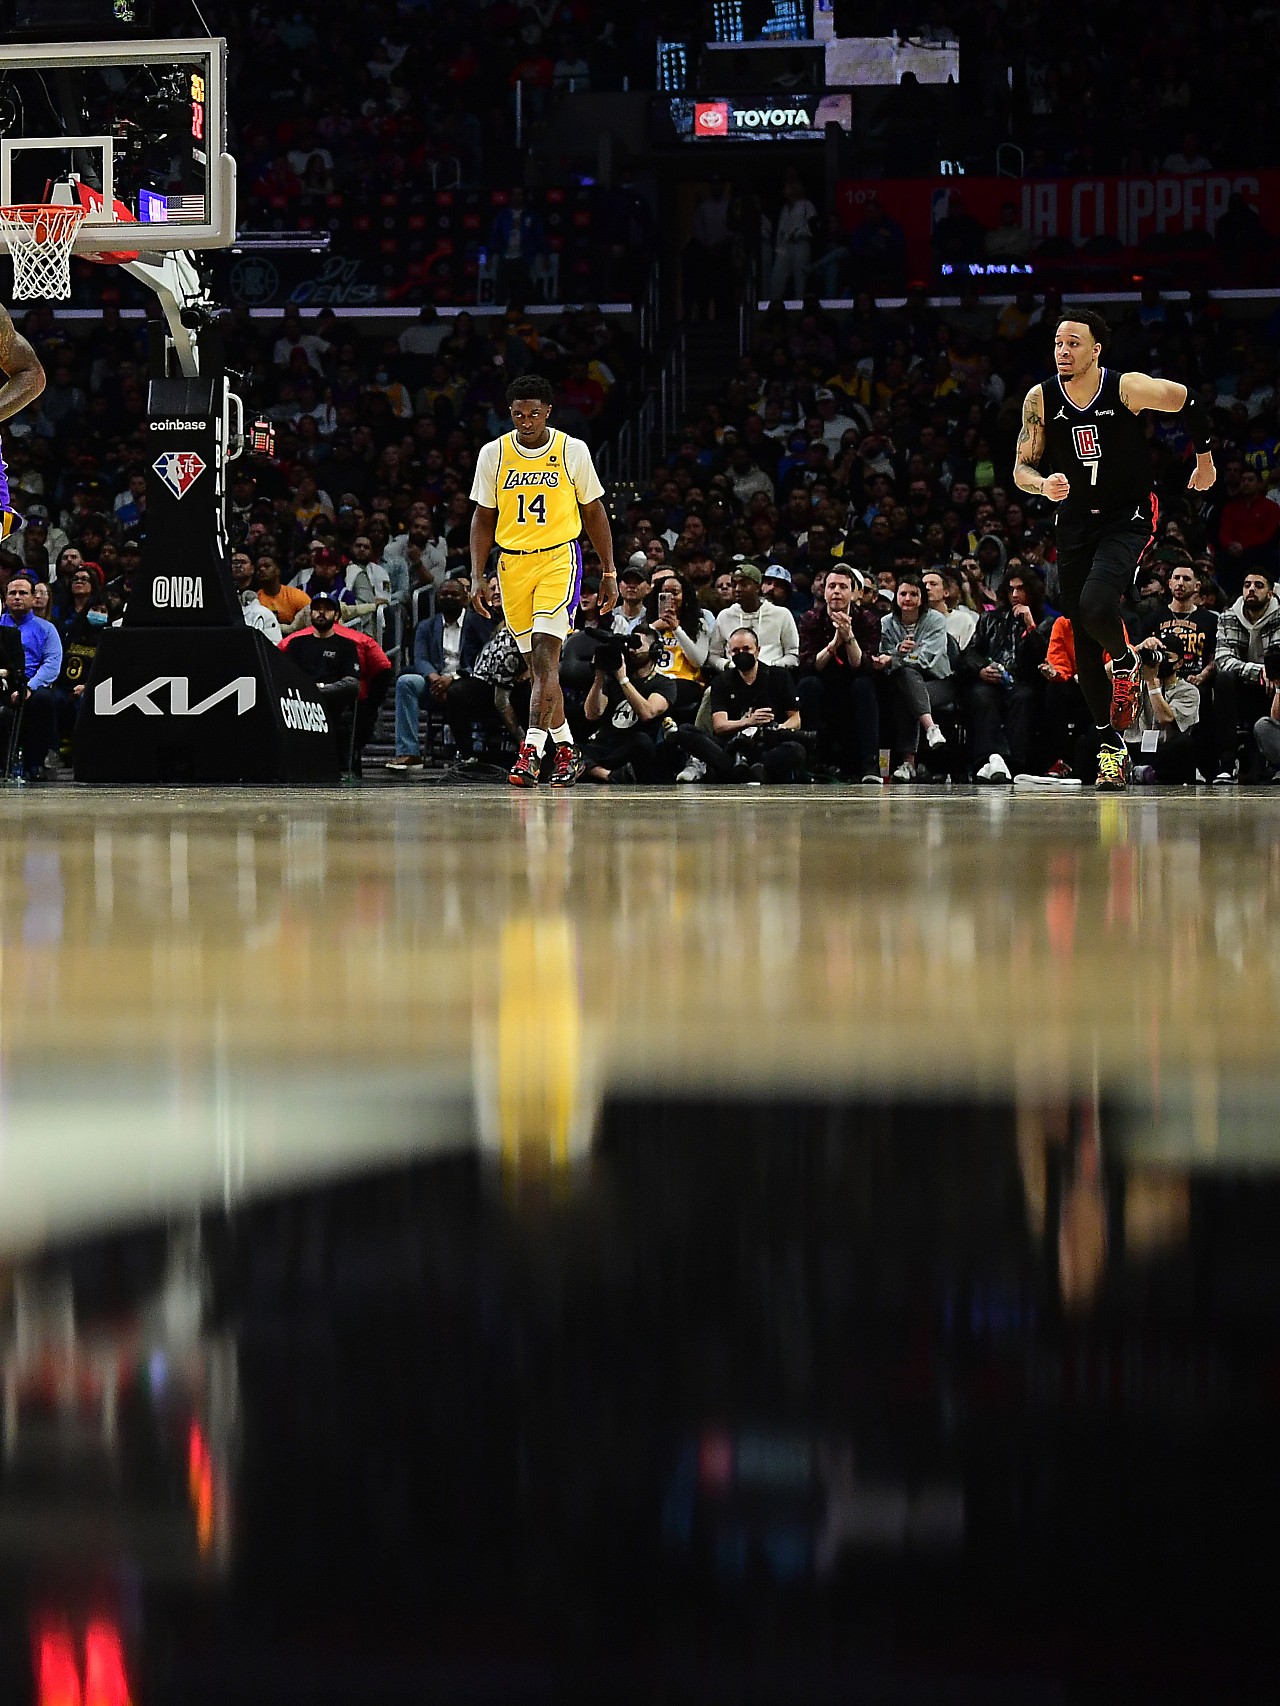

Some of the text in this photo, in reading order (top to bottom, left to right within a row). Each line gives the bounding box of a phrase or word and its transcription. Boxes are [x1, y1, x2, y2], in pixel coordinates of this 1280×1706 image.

[733, 109, 810, 128] TOYOTA
[149, 418, 207, 431] coinbase
[183, 459, 195, 474] 75
[502, 468, 559, 490] LAKERS
[1082, 460, 1099, 486] 7
[516, 493, 547, 525] 14
[152, 576, 204, 609] @NBA
[94, 676, 257, 716] KIA
[280, 688, 329, 734] coinbase
